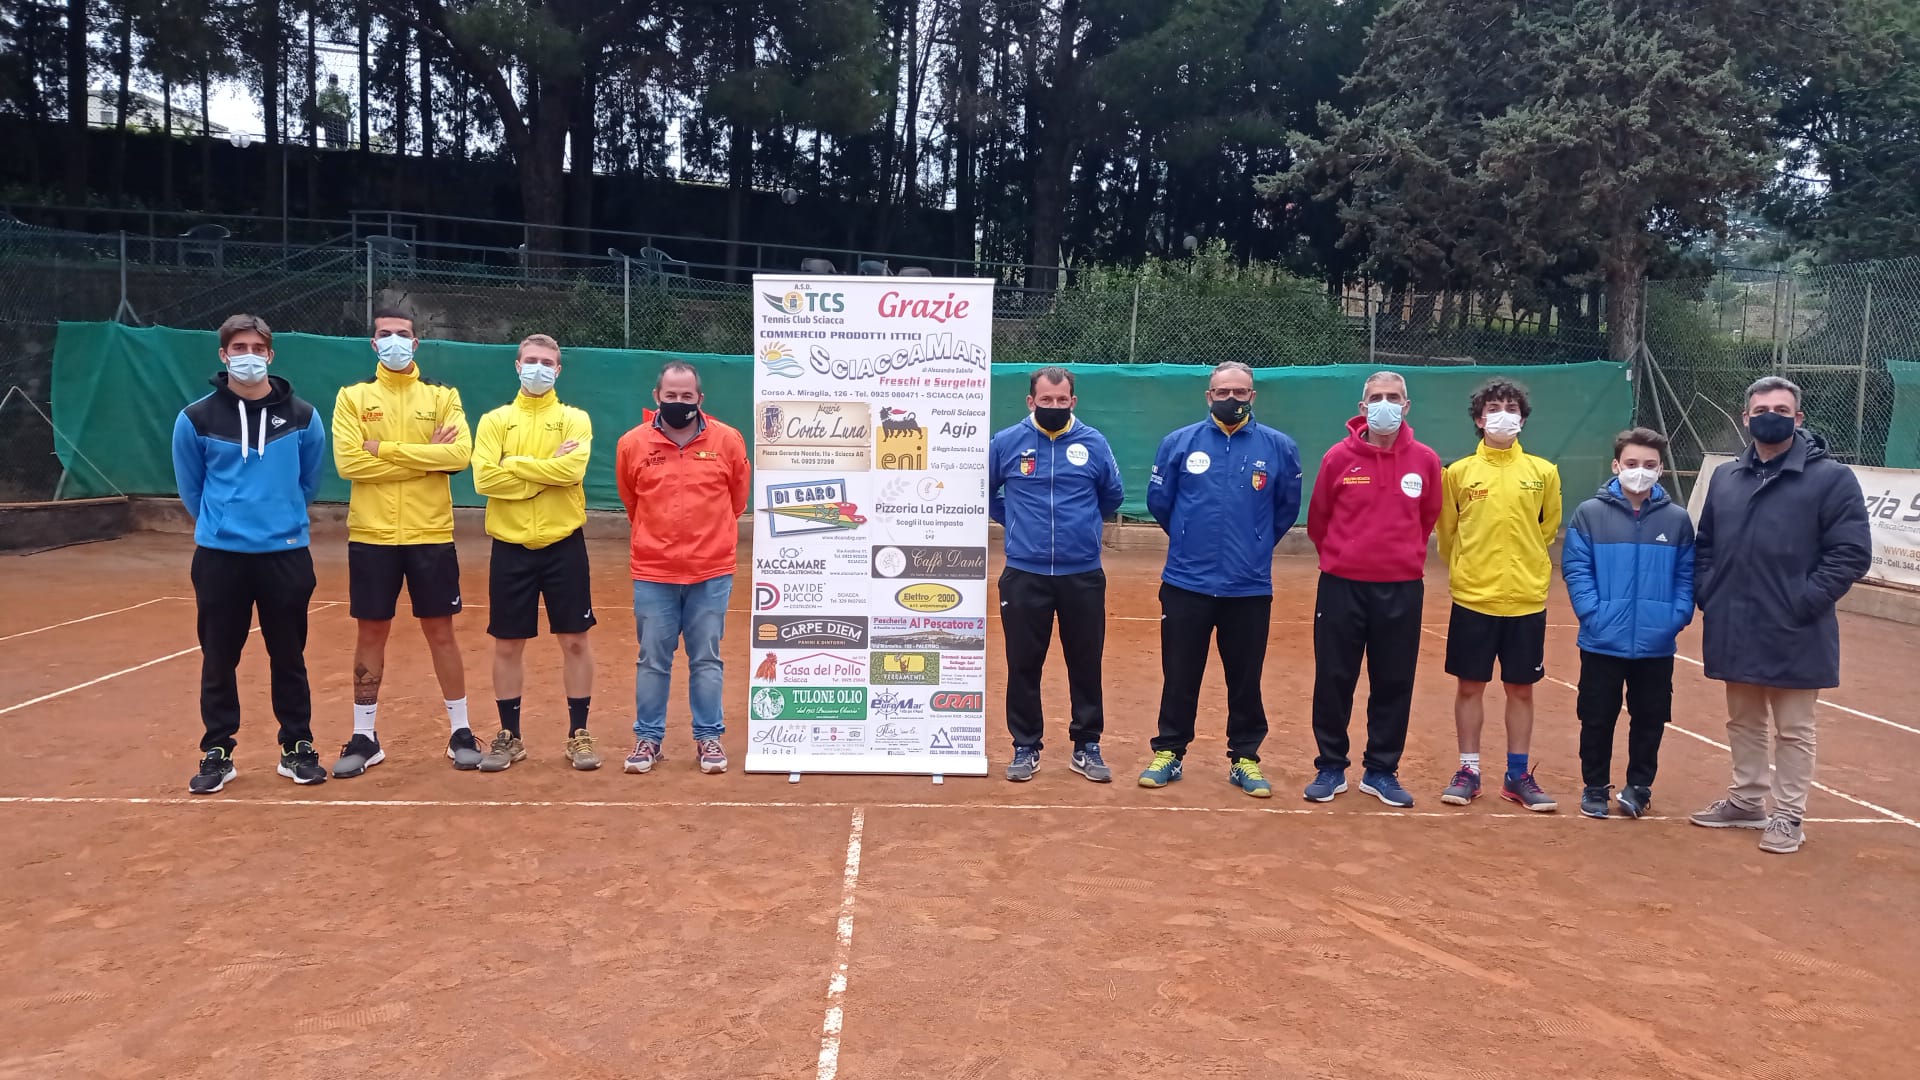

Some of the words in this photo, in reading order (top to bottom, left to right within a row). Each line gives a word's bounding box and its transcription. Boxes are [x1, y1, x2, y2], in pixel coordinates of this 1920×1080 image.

[805, 292, 845, 312] TCS
[878, 292, 970, 324] Grazie
[762, 314, 791, 324] Tennis
[792, 315, 811, 324] Club
[813, 315, 845, 324] Sciacca
[760, 330, 827, 339] COMMERCIO
[830, 332, 886, 340] PRODOTTI
[890, 332, 922, 341] ITTICI
[880, 376, 921, 387] Freschi
[924, 378, 931, 387] e
[934, 378, 986, 390] Surgelati
[966, 392, 984, 400] (AG)
[786, 416, 827, 438] Conte
[830, 416, 868, 439] Luna
[940, 422, 977, 438] Agip
[881, 446, 922, 470] eni
[774, 490, 790, 504] DI
[795, 486, 836, 502] CARO
[876, 503, 918, 514] Pizzeria
[920, 504, 934, 514] La
[936, 504, 985, 515] Pizzaiola
[896, 519, 917, 528] Scogli
[936, 520, 964, 528] impasto
[756, 559, 826, 570] XACCAMARE
[946, 549, 984, 568] Dante
[784, 584, 823, 592] DAVIDE
[784, 593, 823, 602] PUCCIO
[938, 594, 956, 602] 2000
[909, 618, 920, 628] Al
[924, 618, 974, 629] Pescatore
[976, 618, 984, 630] 2
[781, 622, 824, 638] CARPE
[828, 623, 863, 640] DIEM
[783, 664, 810, 676] Casa
[813, 664, 831, 676] del
[834, 664, 861, 676] Pollo
[793, 690, 834, 704] TULONE
[837, 690, 863, 704] OLIO
[934, 694, 982, 710] CRAI
[752, 724, 806, 743] Aliai
[762, 747, 796, 755] Hotel
